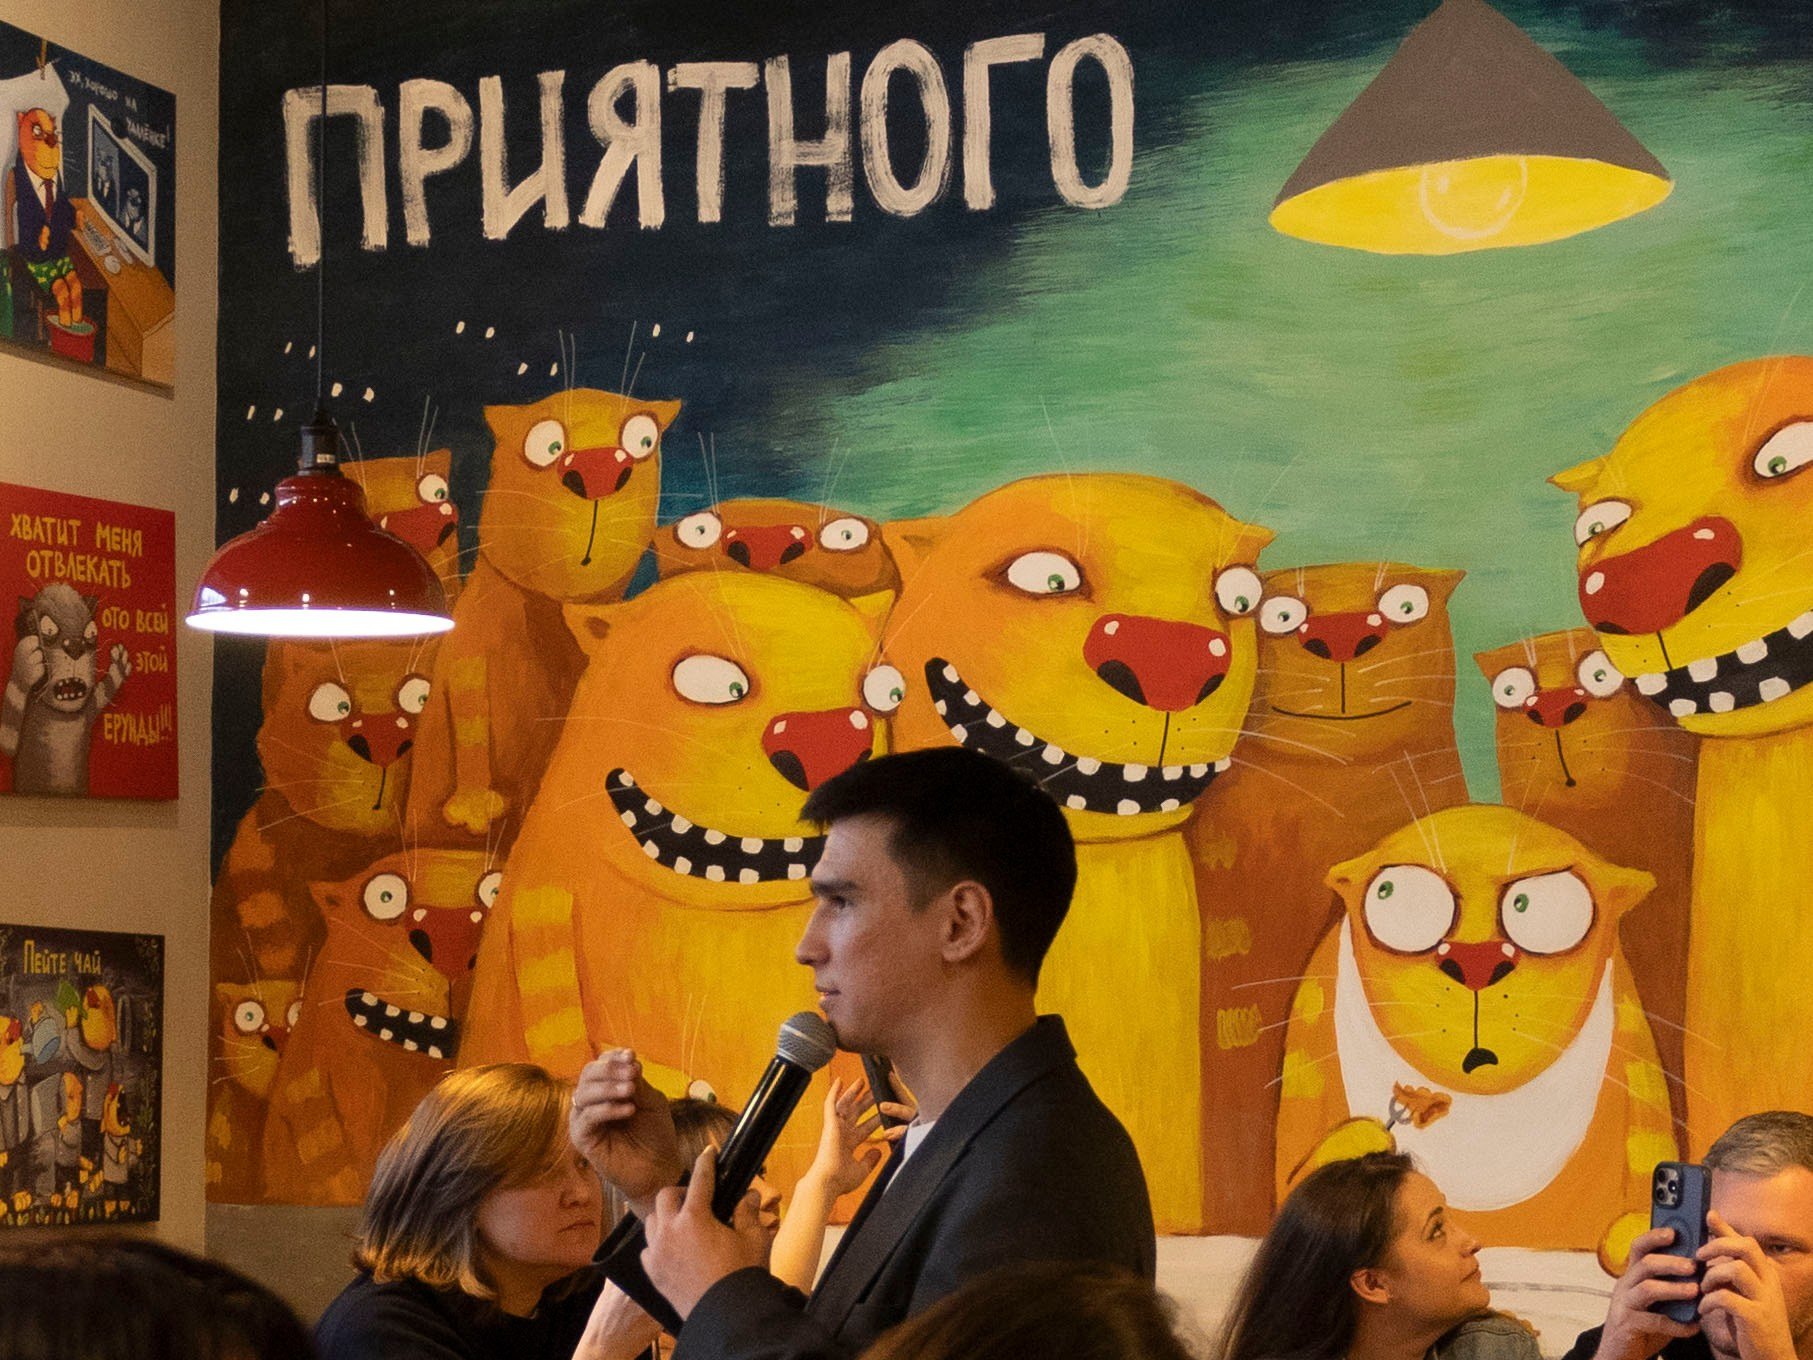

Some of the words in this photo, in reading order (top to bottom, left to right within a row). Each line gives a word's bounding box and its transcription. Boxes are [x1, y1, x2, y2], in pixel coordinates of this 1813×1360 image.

[281, 31, 1136, 272] ПРИЯТНОГО
[10, 513, 81, 546] ХВАТИТ
[96, 520, 143, 557] МЕНЯ
[26, 549, 132, 589] ОТВЛЕКАТЬ
[101, 606, 130, 631] ОТО
[135, 603, 169, 634] ВСЕЙ
[135, 645, 169, 674] ЭТОЙ
